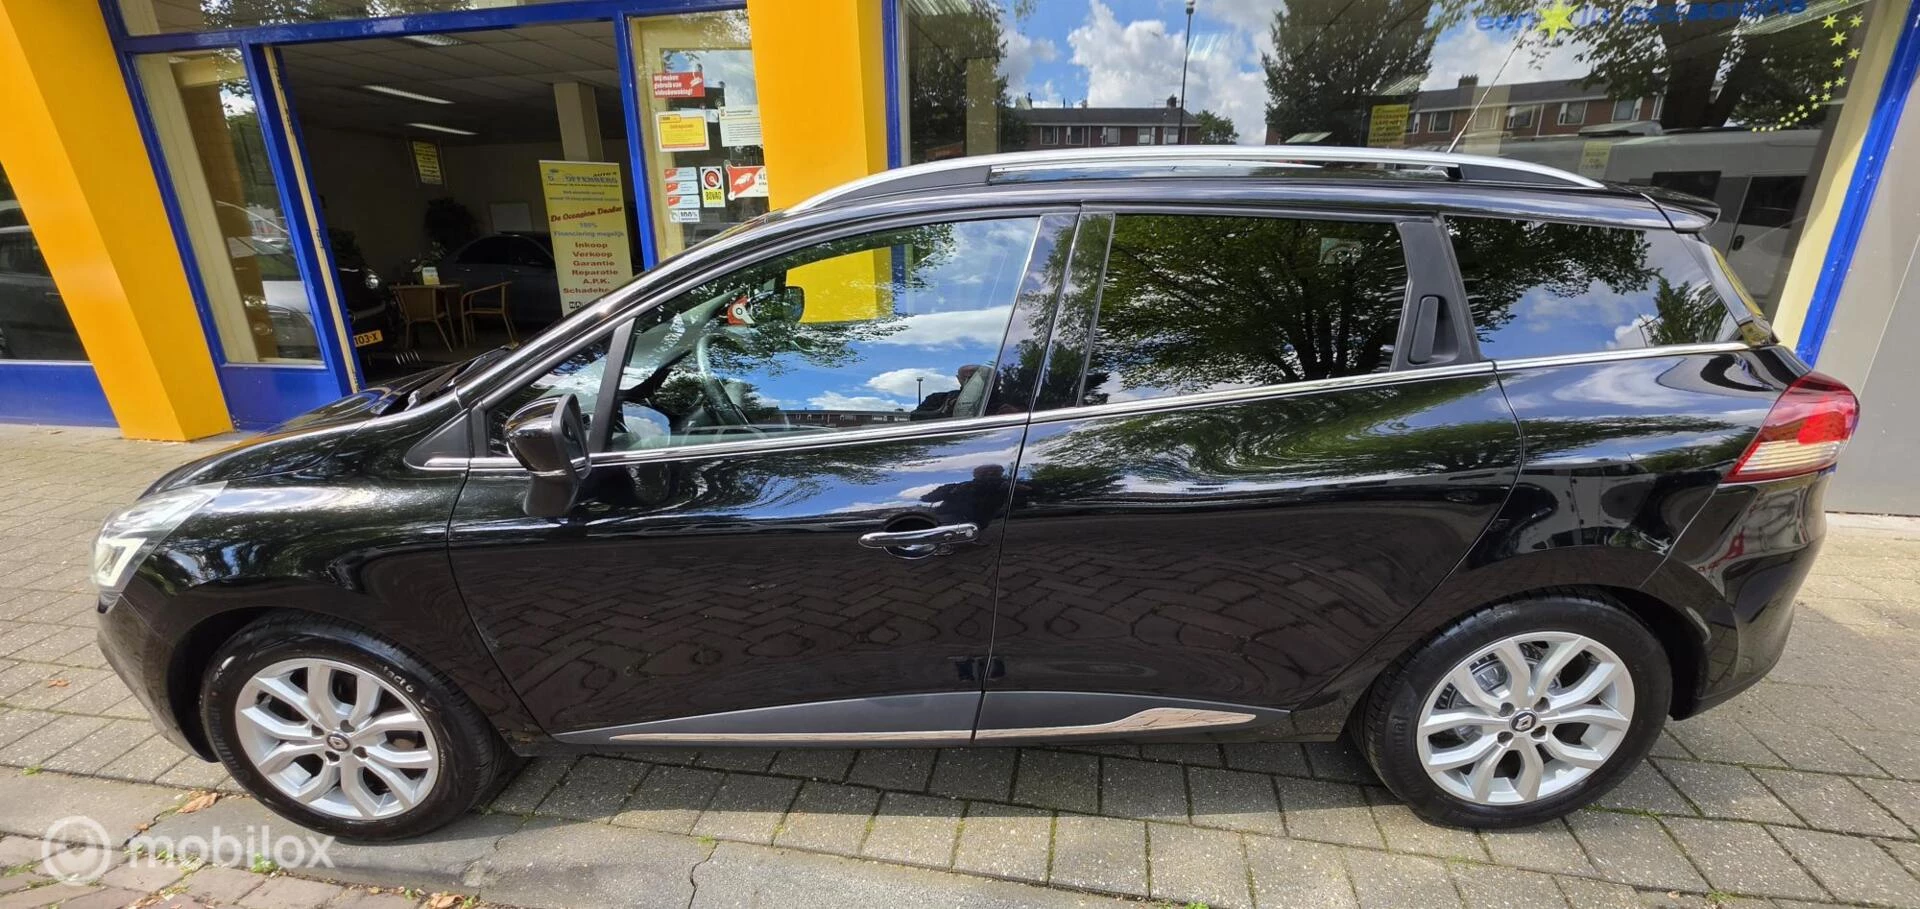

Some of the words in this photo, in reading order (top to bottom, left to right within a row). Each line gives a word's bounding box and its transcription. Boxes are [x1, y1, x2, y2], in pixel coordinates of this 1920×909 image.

[705, 191, 722, 201] BOVAG
[551, 214, 561, 222] De
[563, 209, 596, 221] Occasion
[597, 205, 622, 215] Dealer
